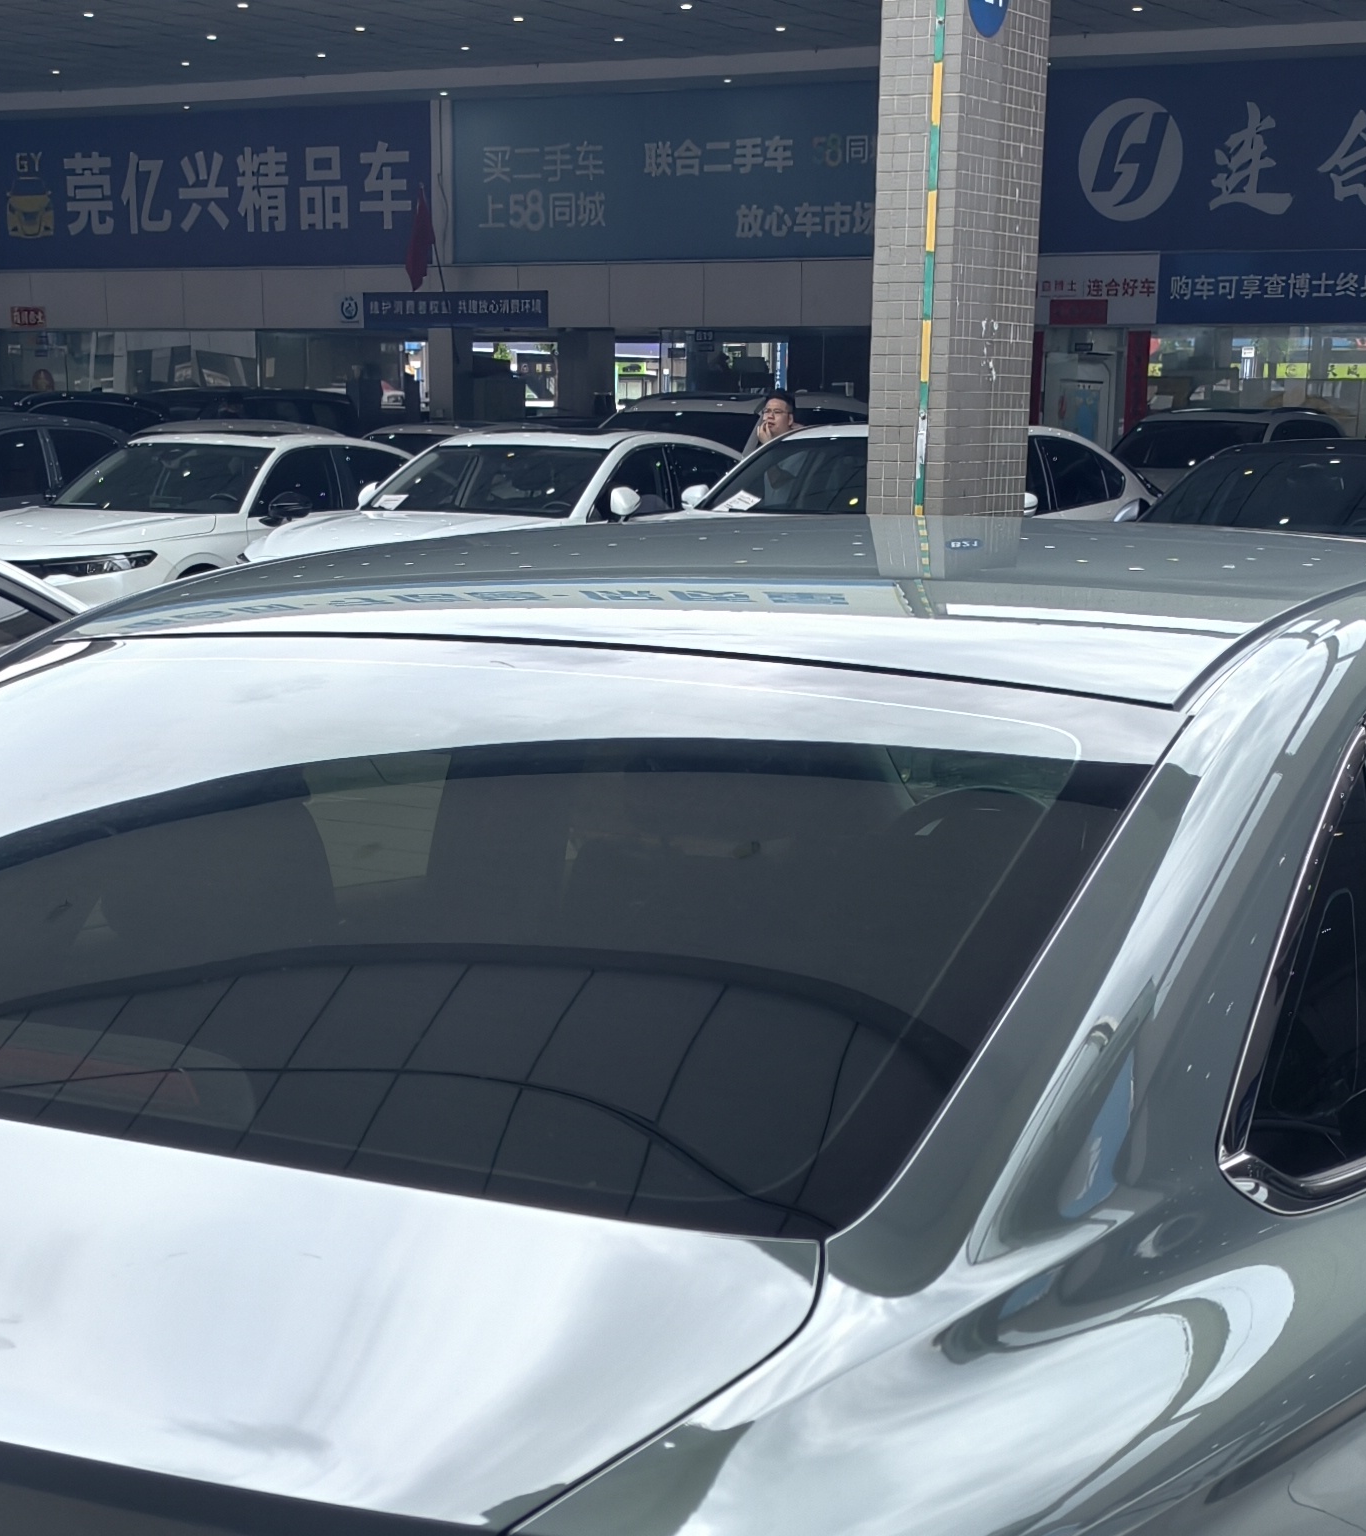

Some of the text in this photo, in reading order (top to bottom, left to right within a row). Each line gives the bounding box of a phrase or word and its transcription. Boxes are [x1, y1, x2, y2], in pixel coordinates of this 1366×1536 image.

[16, 152, 43, 173] GY
[482, 141, 605, 183] 买二手车
[644, 135, 794, 176] 联合二手车
[813, 134, 876, 167] 58同
[63, 141, 413, 236] 莞亿兴精品车
[478, 188, 606, 231] 上58同城
[1086, 278, 1156, 298] 连合好车
